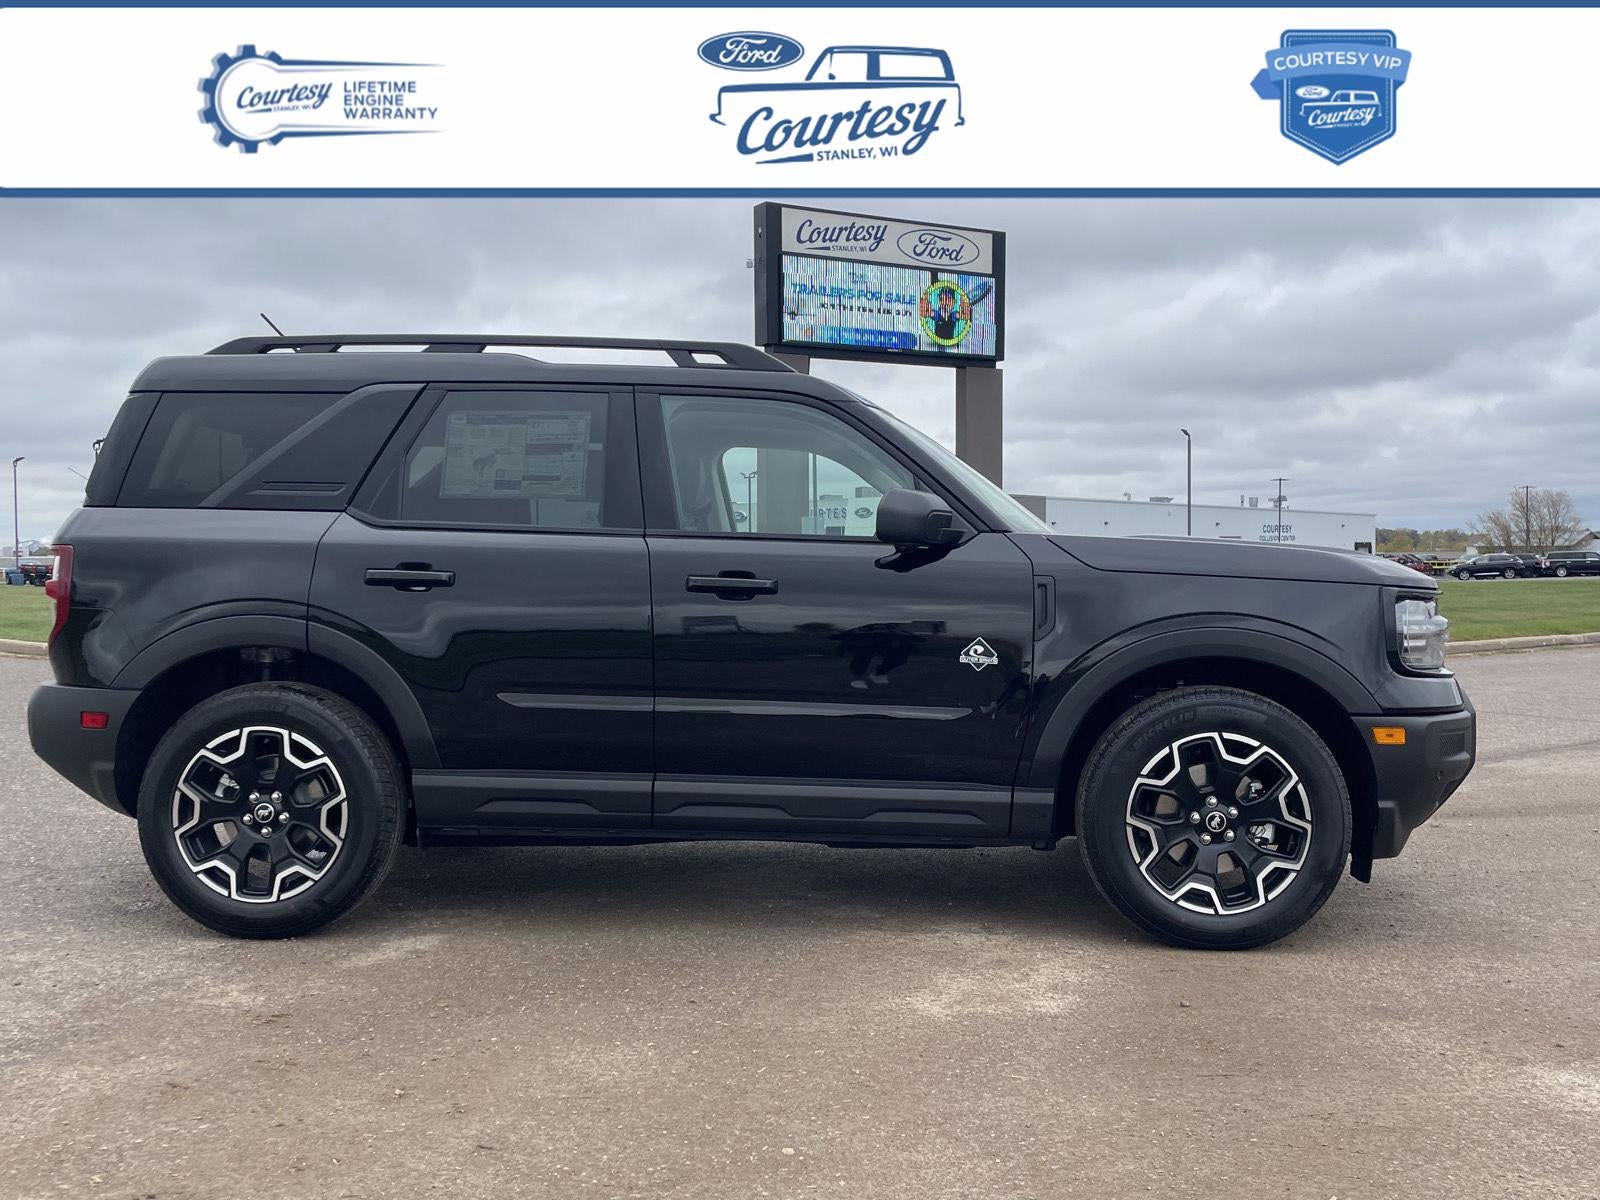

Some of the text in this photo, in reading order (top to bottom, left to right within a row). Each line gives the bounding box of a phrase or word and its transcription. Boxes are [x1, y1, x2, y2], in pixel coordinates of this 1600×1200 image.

[796, 219, 889, 252] Courtesy
[913, 232, 965, 262] Ford
[858, 289, 882, 301] FOR
[885, 292, 917, 305] SALE
